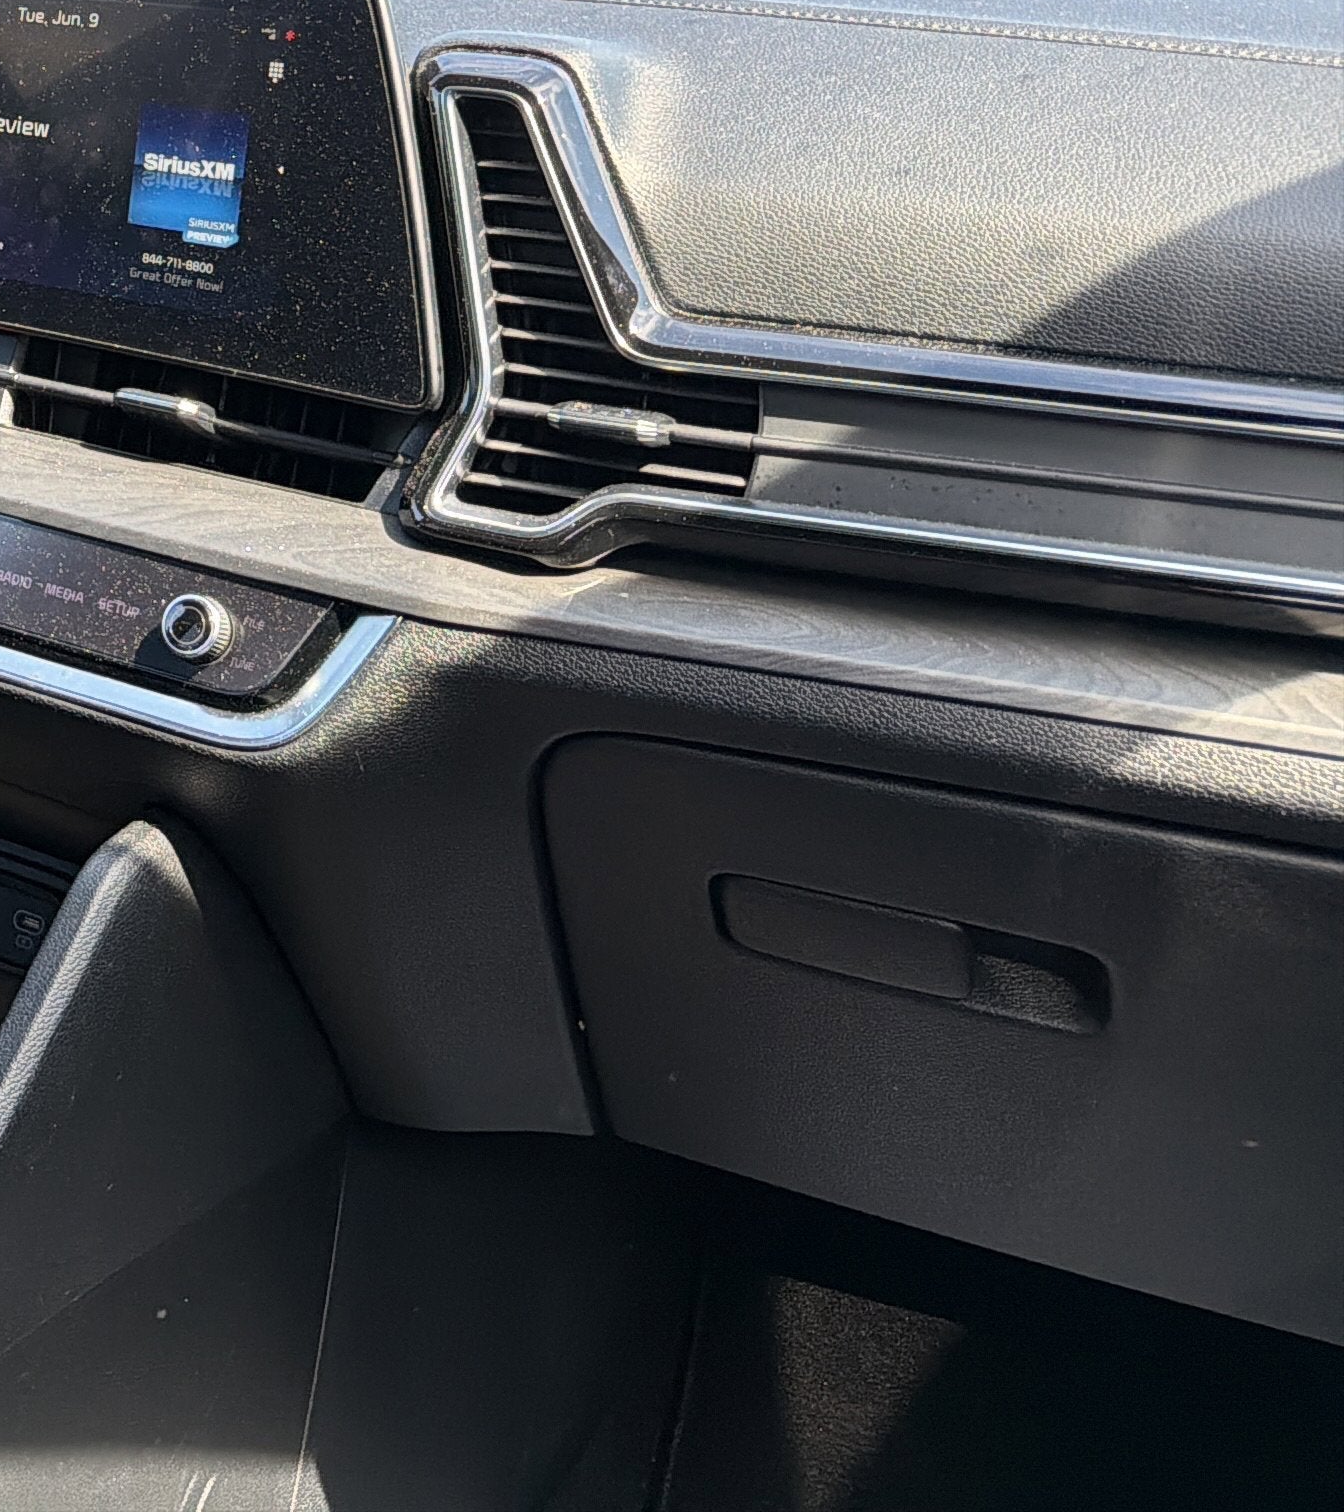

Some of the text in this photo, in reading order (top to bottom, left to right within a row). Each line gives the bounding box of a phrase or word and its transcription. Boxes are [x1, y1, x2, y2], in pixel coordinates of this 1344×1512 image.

[88, 13, 100, 28] 9
[143, 152, 236, 181] SiriusXM
[186, 231, 232, 245] PREVIEW
[141, 252, 214, 275] 844-711-8800
[129, 266, 225, 294] Great Offer Now!
[44, 582, 85, 604] MEDIA
[98, 597, 141, 619] SETUP
